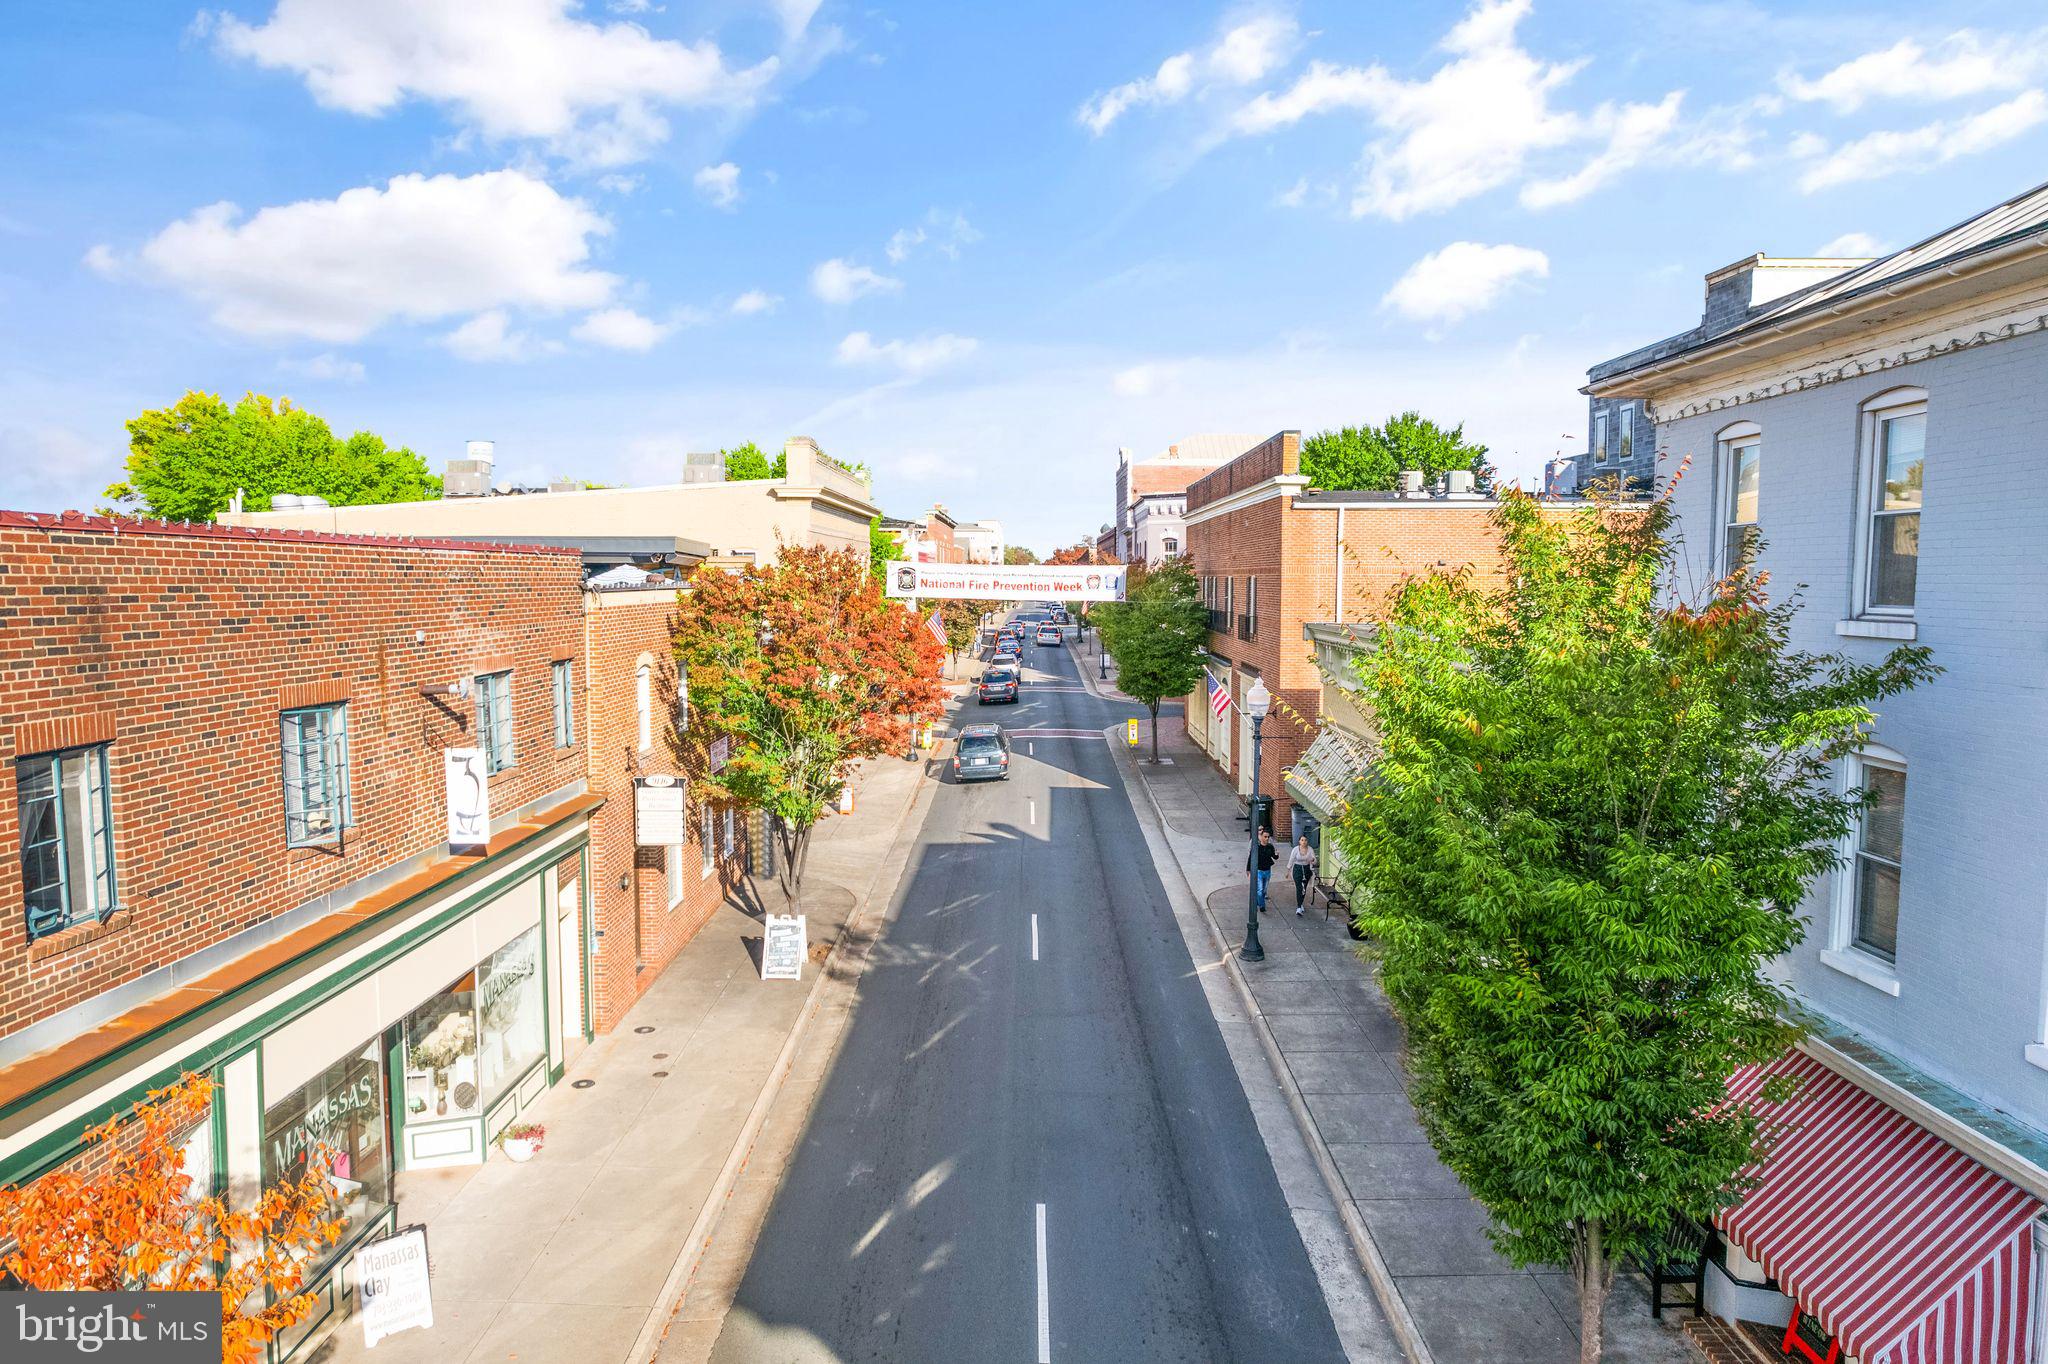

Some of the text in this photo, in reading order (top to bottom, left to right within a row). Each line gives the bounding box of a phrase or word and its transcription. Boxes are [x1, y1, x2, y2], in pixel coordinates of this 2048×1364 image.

[920, 578, 1083, 592] National Fire Prevention Week
[275, 1074, 372, 1180] MANASSAS
[363, 1243, 420, 1274] Manassas
[364, 1276, 391, 1297] Clay
